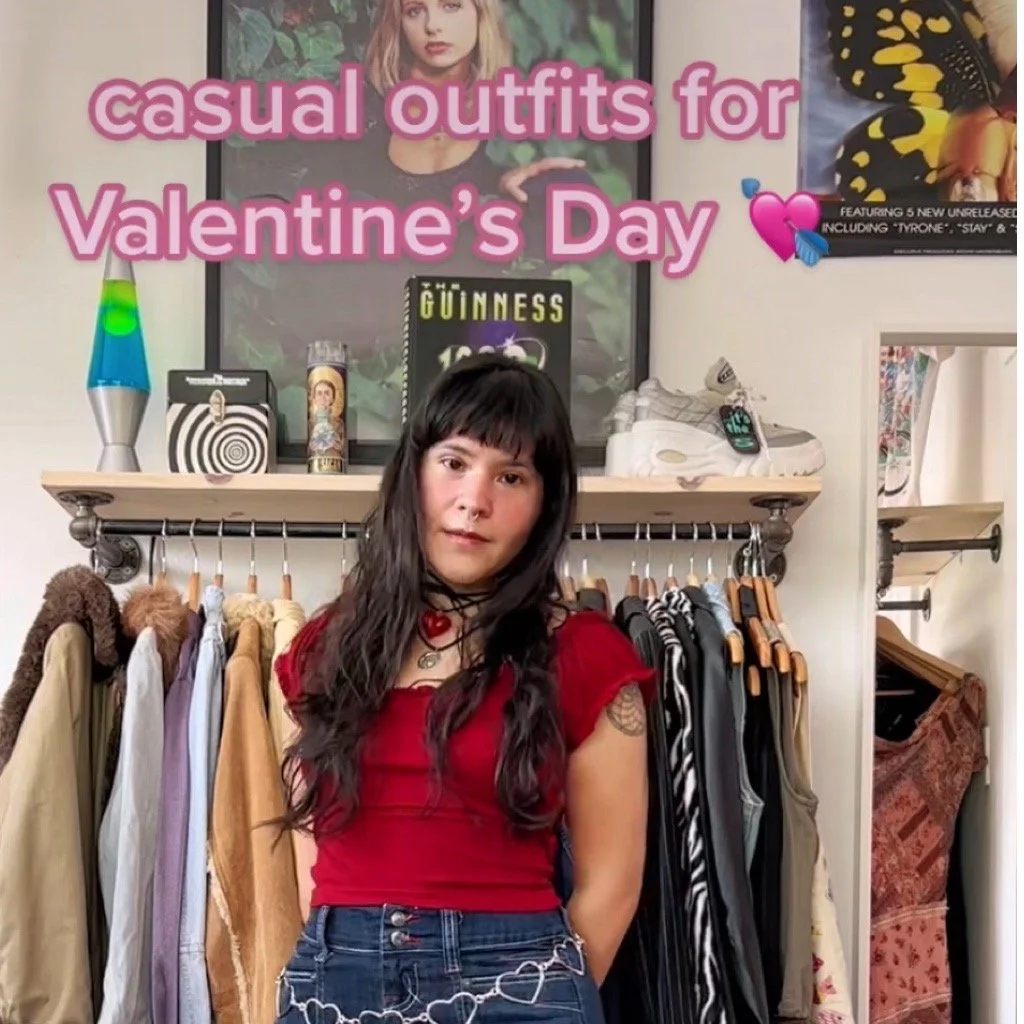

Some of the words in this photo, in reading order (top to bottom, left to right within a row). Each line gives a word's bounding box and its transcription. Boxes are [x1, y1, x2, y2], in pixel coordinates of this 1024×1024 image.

[839, 206, 903, 218] FEATURING
[906, 207, 915, 218] 5
[916, 207, 946, 219] NEW
[821, 222, 889, 234] INCLUDING
[995, 223, 1007, 234] &
